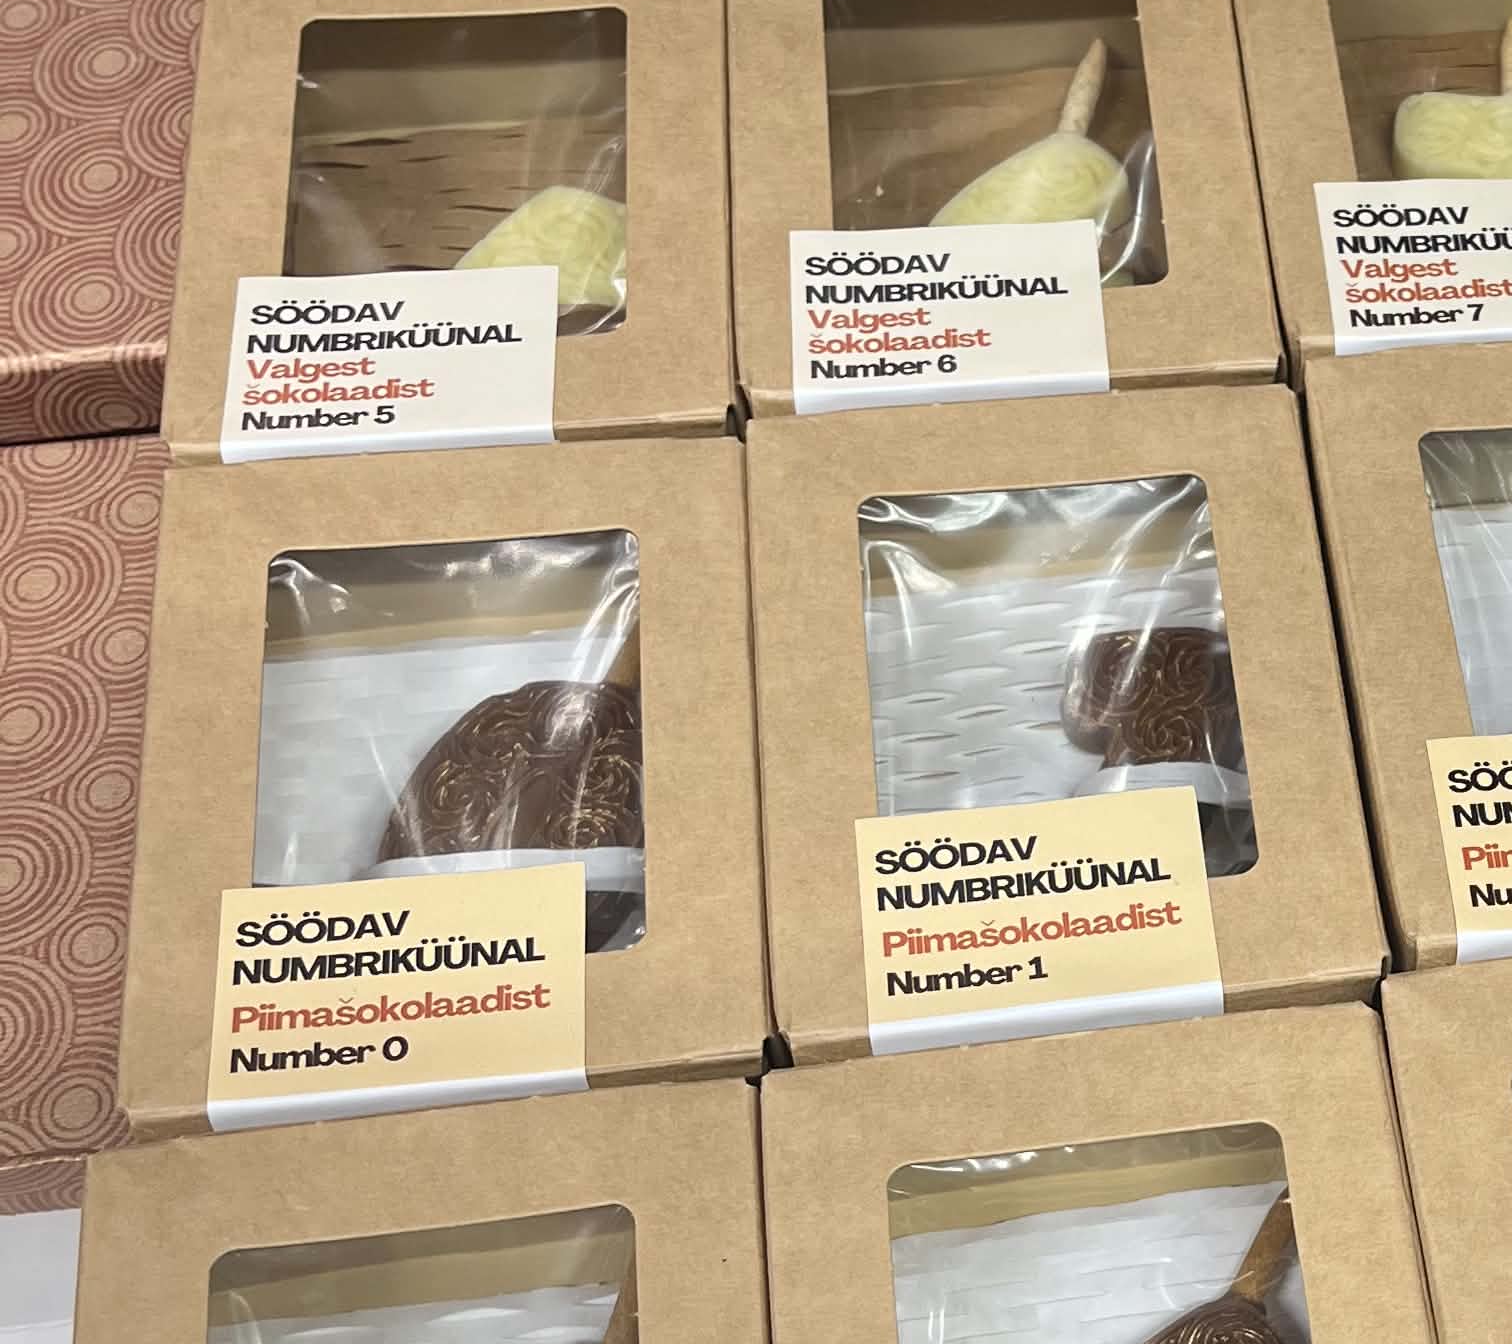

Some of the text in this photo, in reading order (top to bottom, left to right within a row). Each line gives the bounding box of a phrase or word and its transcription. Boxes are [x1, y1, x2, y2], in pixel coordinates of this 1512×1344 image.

[1332, 203, 1470, 228] SÖÖDAV
[804, 251, 951, 277] SÖÖDAV
[1340, 258, 1459, 281] Valgest
[805, 273, 1069, 305] NUMBRIKÜÜNAL
[249, 299, 405, 326] SÖÖDAV
[807, 307, 932, 331] Valgest
[1349, 303, 1485, 328] Number 7
[246, 321, 523, 354] NUMBRIKÜÜNAL
[808, 328, 993, 355] šokolaadist
[247, 356, 377, 381] Valgest
[810, 353, 958, 379] Number 6
[242, 378, 435, 406] šokolaadist
[241, 404, 396, 431] Number 5
[874, 835, 1038, 876] SÖÖDAV
[876, 857, 1172, 913] NUMBRIKÜÜNAL
[235, 909, 411, 948] SÖÖDAV
[882, 901, 1183, 958] Piimašokolaadist
[231, 935, 546, 986] NUMBRIKÜÜNAL
[886, 955, 1049, 997] Number 1
[231, 983, 551, 1034] Piimašokolaadist
[229, 1035, 409, 1074] Number 0
